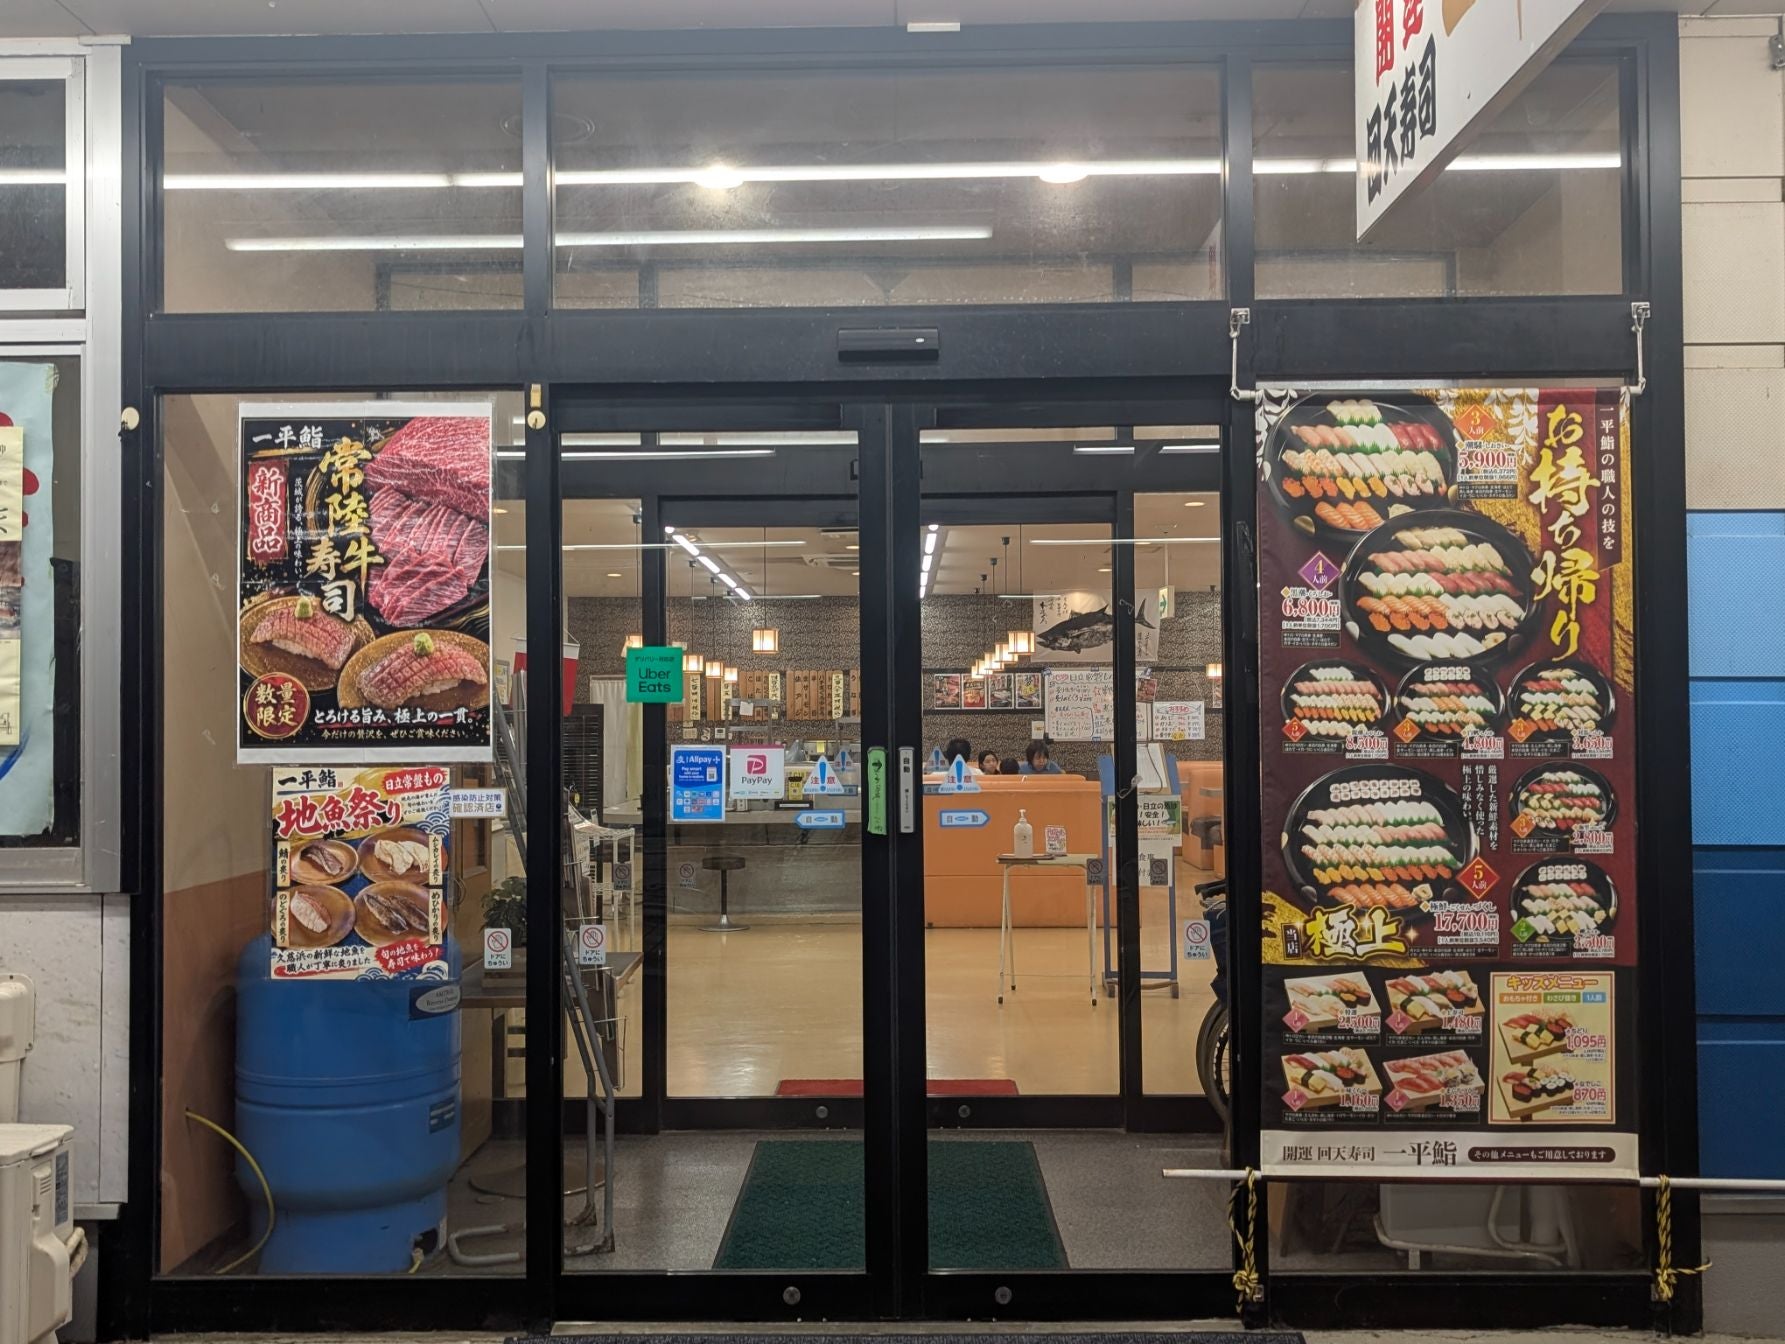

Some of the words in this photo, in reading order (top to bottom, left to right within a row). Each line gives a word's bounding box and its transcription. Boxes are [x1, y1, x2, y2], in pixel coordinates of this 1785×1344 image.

[1471, 410, 1481, 426] 3
[252, 424, 324, 450] 一平鮨
[1468, 426, 1484, 435] 人前
[1458, 450, 1516, 470] 5,900円
[1600, 406, 1616, 550] 一平鮨の職人の技を
[252, 466, 285, 553] 新商品
[1529, 404, 1601, 662] お持ち帰り
[1314, 559, 1325, 574] 4
[1312, 575, 1328, 584] 人前
[1281, 599, 1340, 617] 6,800円
[638, 668, 671, 680] Uber
[256, 684, 297, 706] 数量
[638, 681, 671, 693] Eats
[256, 706, 298, 727] 限定
[277, 768, 337, 790] 一平鮨
[741, 776, 773, 786] PayPay
[276, 786, 402, 838] 地魚祭り
[1473, 865, 1483, 880] 5
[1471, 880, 1487, 890] 人前
[1434, 913, 1498, 931] 17,700円
[1305, 907, 1406, 956] 極上
[1506, 975, 1599, 990] キッズメニュー
[1574, 1089, 1606, 1101] 870円
[1282, 1145, 1313, 1161] 開運
[1383, 1140, 1457, 1166] 一平鮨
